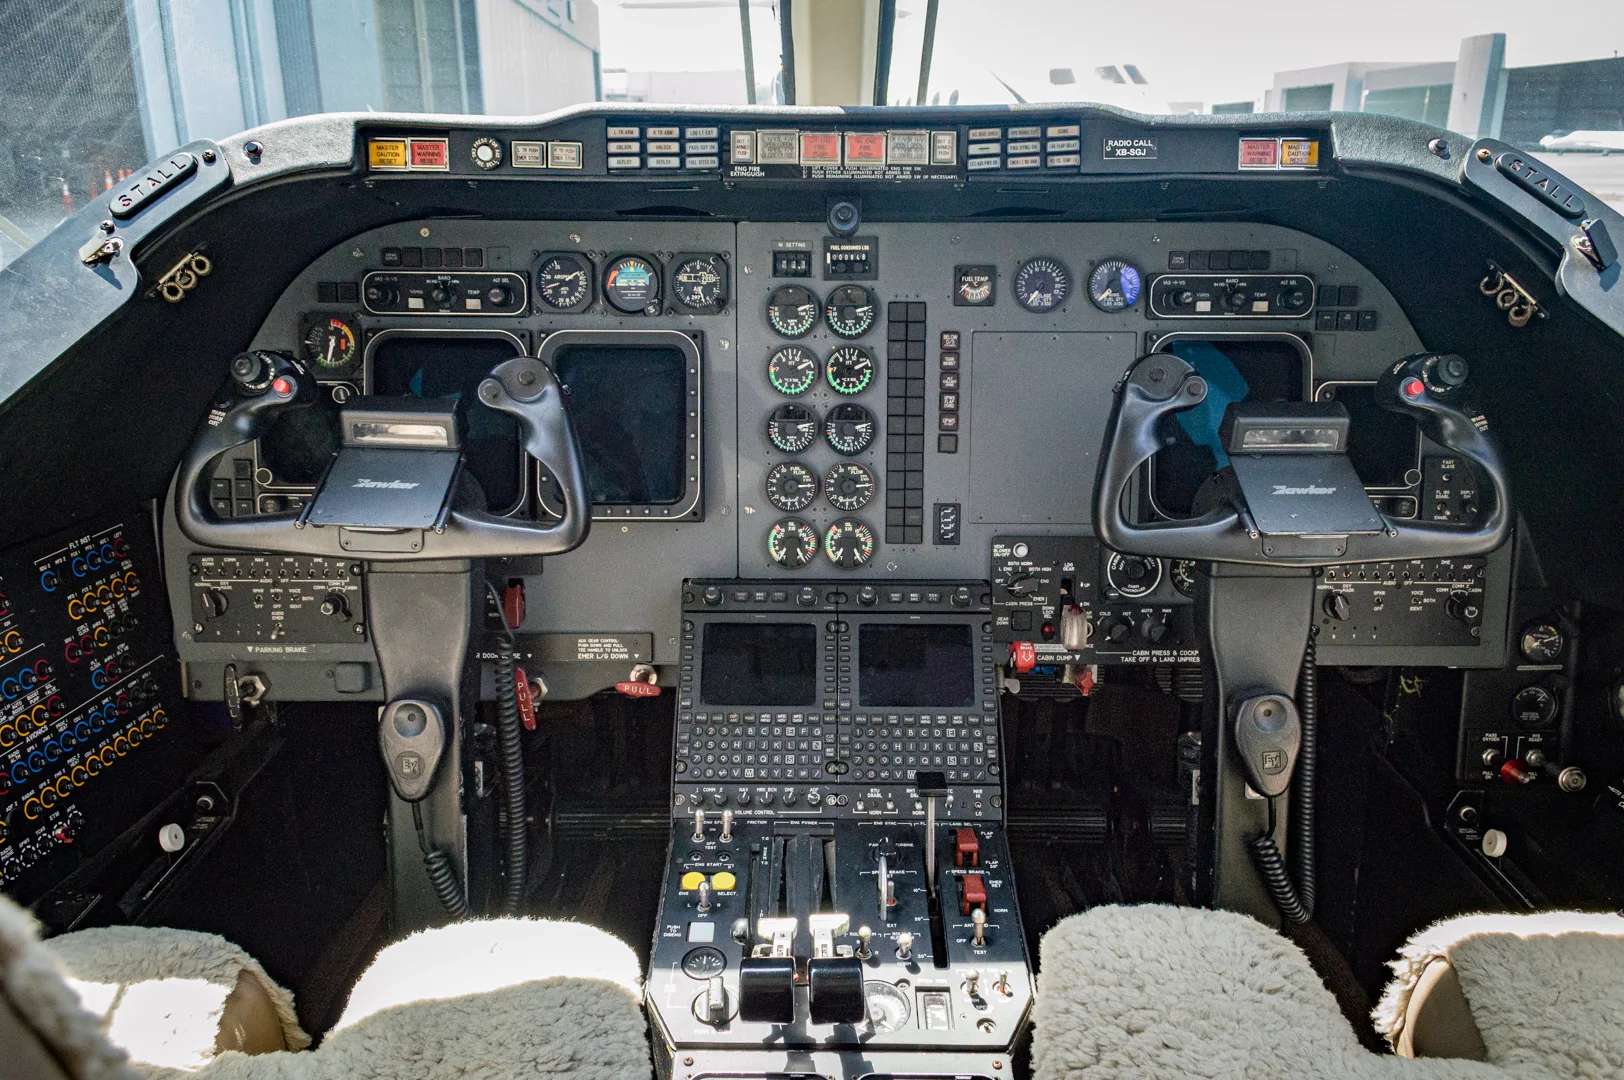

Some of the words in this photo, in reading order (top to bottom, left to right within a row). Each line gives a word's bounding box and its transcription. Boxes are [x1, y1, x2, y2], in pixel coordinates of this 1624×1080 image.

[1108, 139, 1132, 147] RADIO
[1133, 139, 1152, 147] CALL
[1115, 148, 1146, 156] XB-SGJ
[118, 160, 187, 207] STALL
[1509, 159, 1574, 209] STALL
[69, 539, 80, 550] FLT
[79, 535, 91, 546] INST
[624, 684, 652, 695] PULL
[517, 682, 531, 722] PULL
[25, 725, 49, 744] AVIONICS
